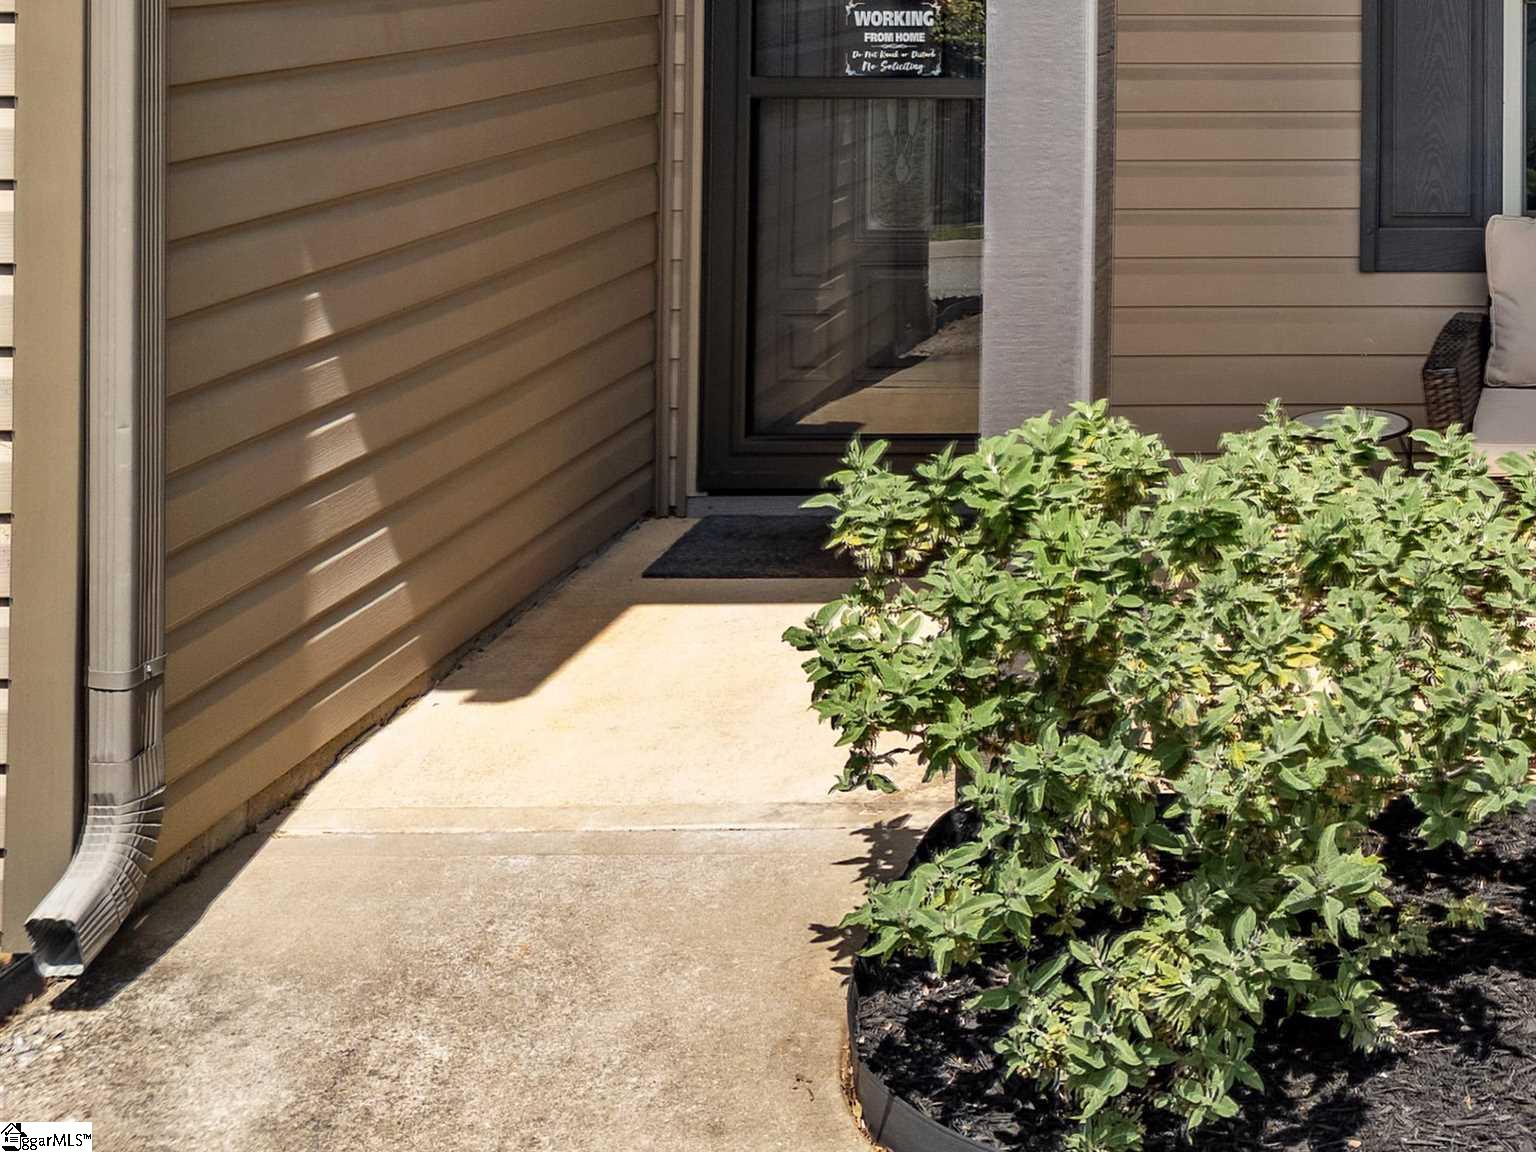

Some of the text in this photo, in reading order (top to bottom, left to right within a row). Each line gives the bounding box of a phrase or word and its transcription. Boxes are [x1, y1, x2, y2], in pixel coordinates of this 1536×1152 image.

[854, 10, 935, 27] WORKING
[864, 32, 926, 43] FROM HOME
[862, 61, 876, 72] No
